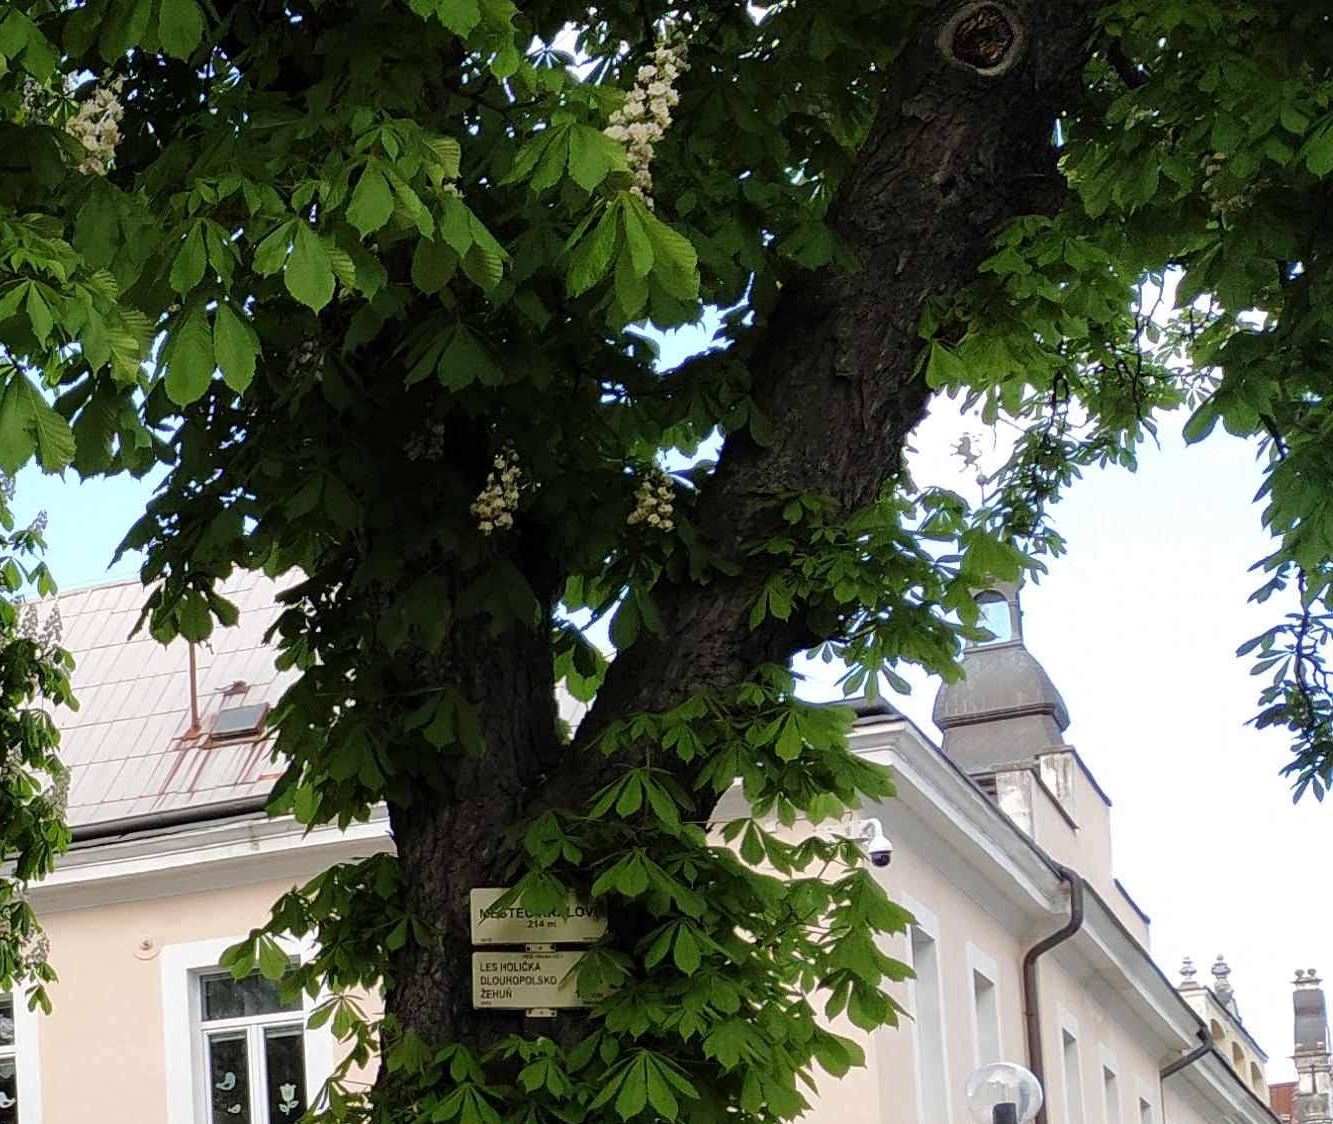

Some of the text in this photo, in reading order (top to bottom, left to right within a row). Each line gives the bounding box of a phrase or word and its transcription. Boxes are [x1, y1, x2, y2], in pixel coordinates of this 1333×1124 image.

[479, 961, 542, 973] LES HOLIČKA
[479, 975, 558, 986] DLOUHOPOLSKO
[479, 987, 513, 1000] ŽEHUŇ
